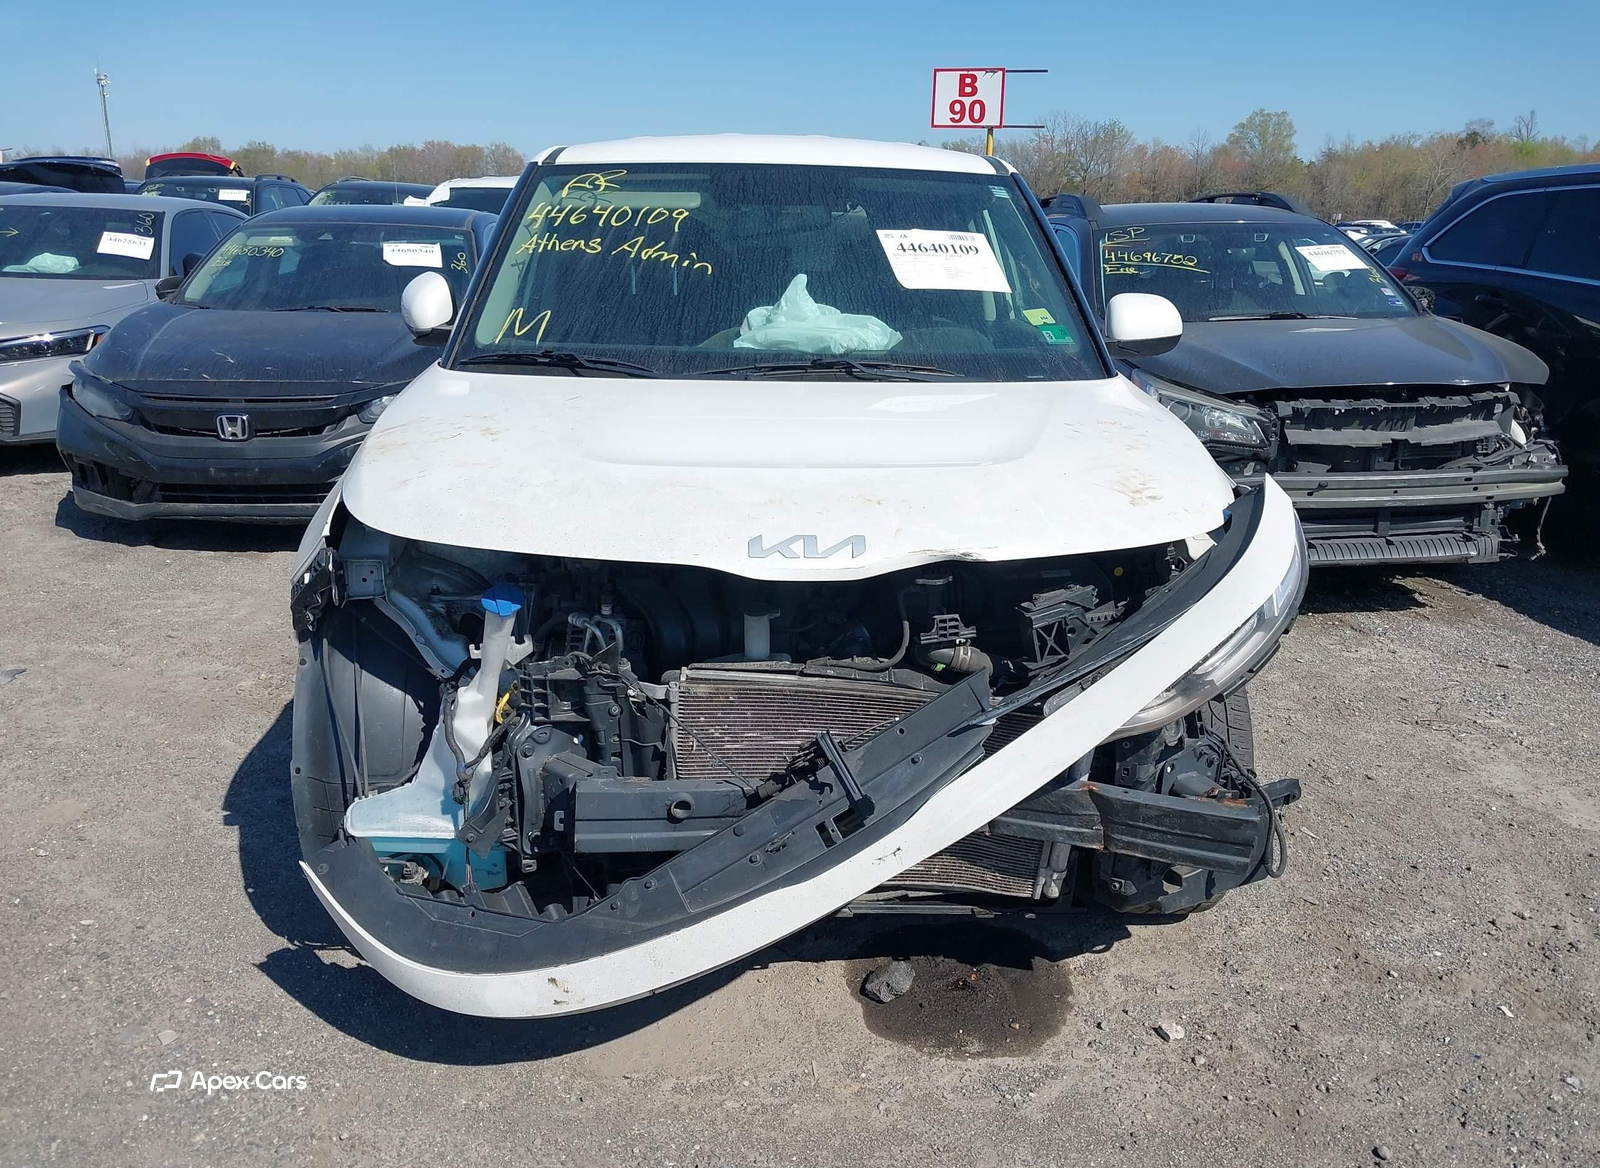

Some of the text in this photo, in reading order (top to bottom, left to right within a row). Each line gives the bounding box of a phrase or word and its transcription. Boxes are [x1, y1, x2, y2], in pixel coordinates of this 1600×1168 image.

[958, 73, 978, 97] B
[949, 99, 986, 123] 90
[527, 202, 689, 232] 44640109
[516, 233, 712, 275] Athens Admin
[896, 242, 979, 256] 44640109
[1104, 249, 1198, 267] 44696752
